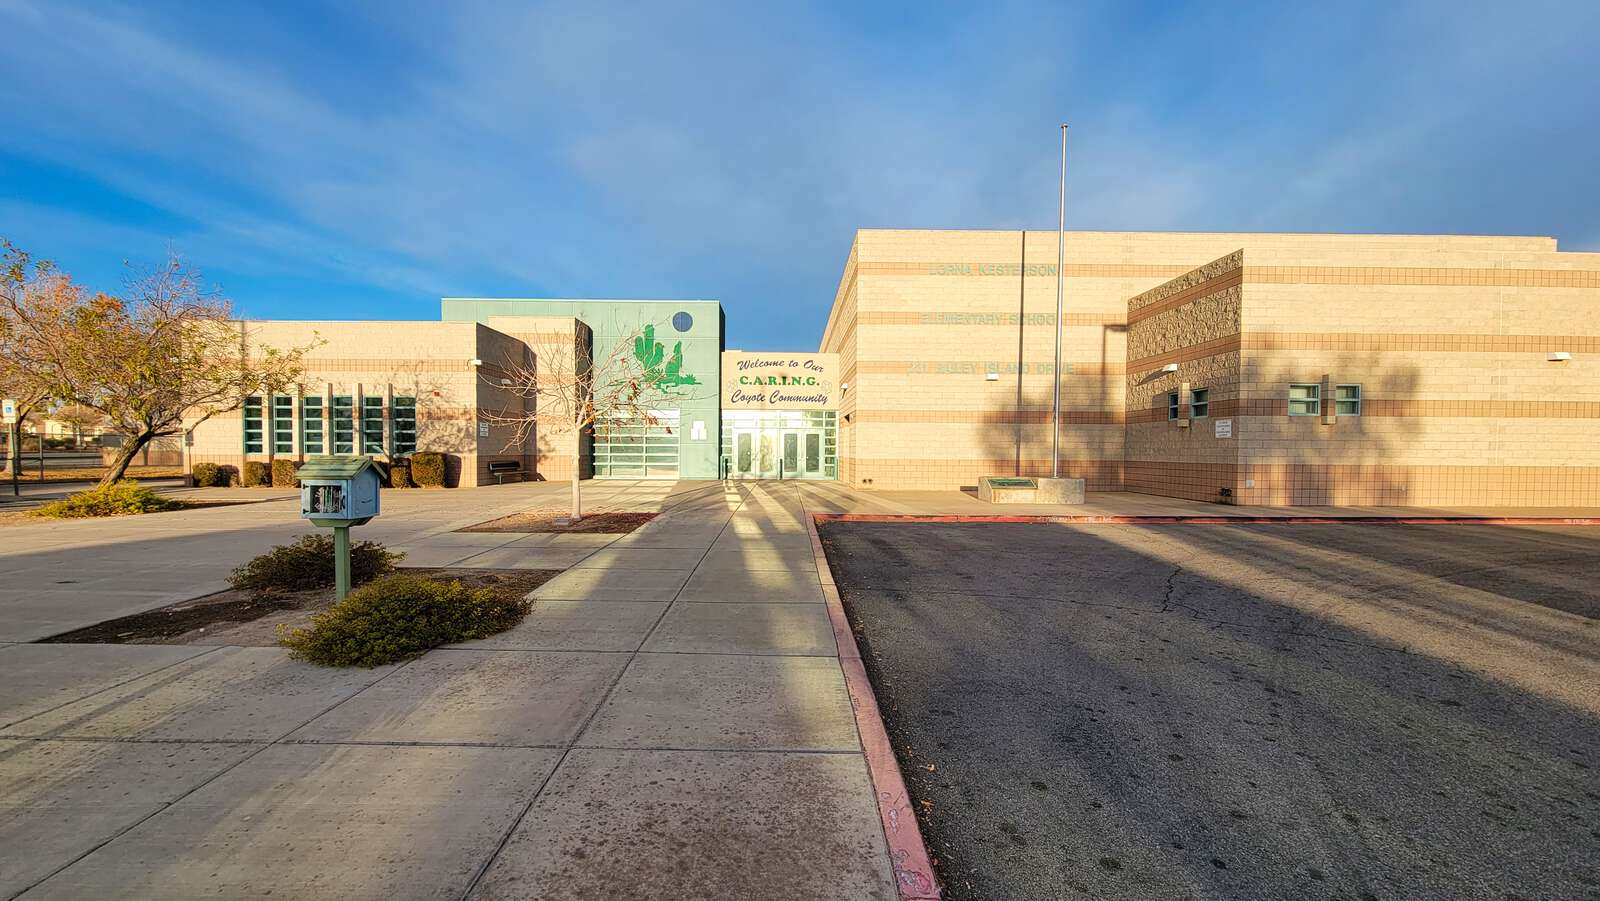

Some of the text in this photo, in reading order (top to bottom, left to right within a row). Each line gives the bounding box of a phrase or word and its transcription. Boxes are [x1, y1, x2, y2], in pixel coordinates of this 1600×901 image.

[737, 359, 824, 373] Welcome to Our
[739, 376, 820, 386] C.A.R.I.N.G.
[731, 390, 829, 405] Coyote Community
